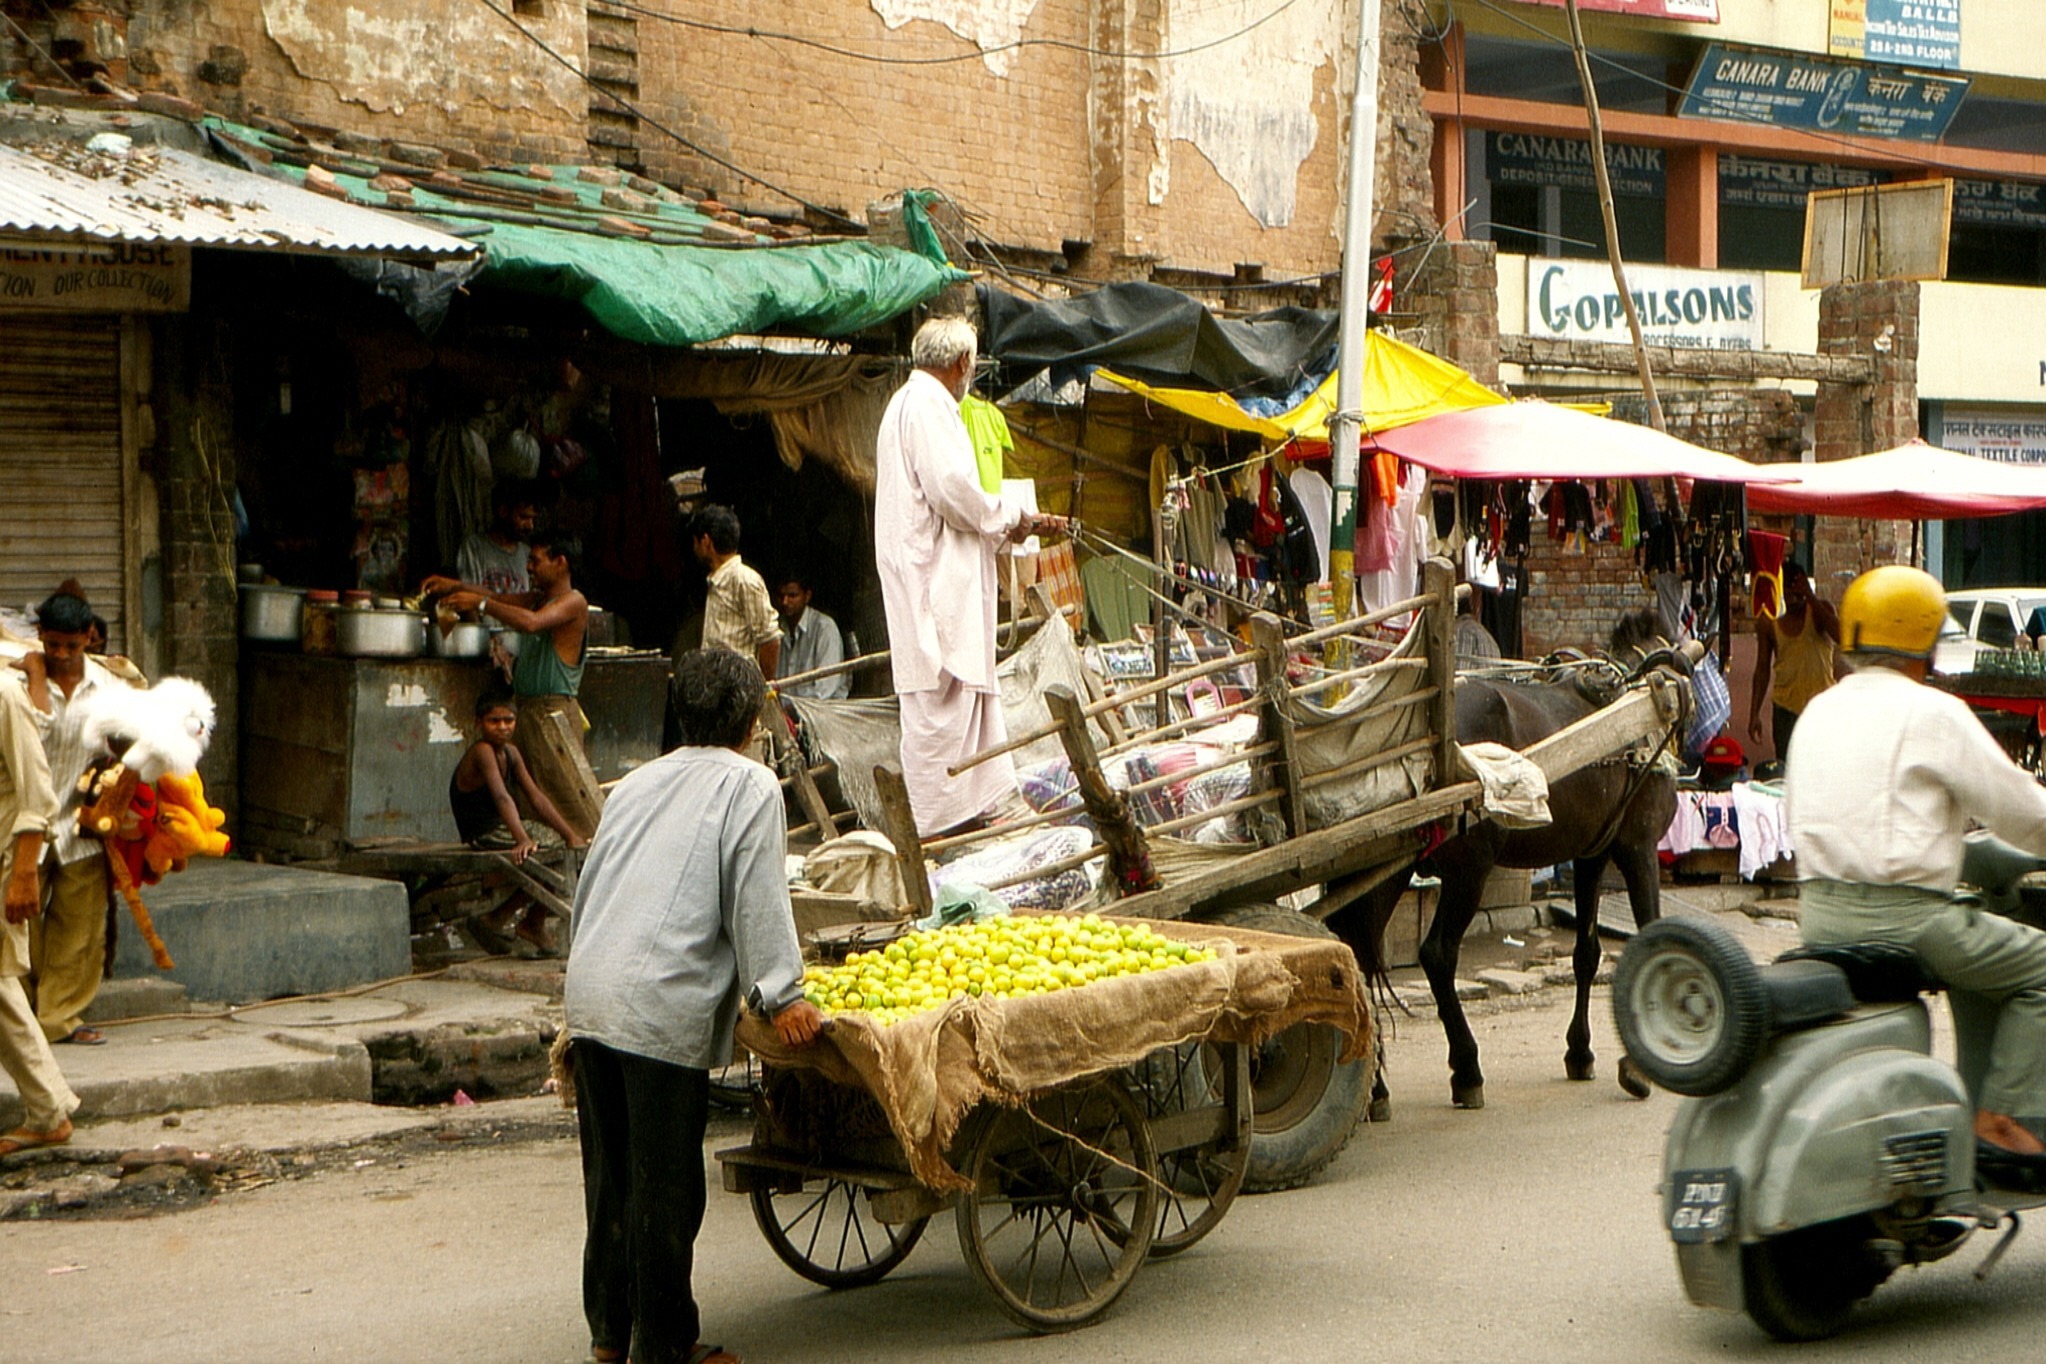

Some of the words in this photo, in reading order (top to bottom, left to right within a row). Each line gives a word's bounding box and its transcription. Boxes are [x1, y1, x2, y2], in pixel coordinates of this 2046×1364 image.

[1917, 45, 1952, 61] FLOOR
[1715, 58, 1781, 87] CANARA
[1785, 67, 1831, 93] BANK
[1496, 132, 1591, 163] CANARA
[54, 271, 85, 295] OUR
[88, 269, 176, 305] COLLECTION
[1981, 448, 2018, 462] TEXTILE
